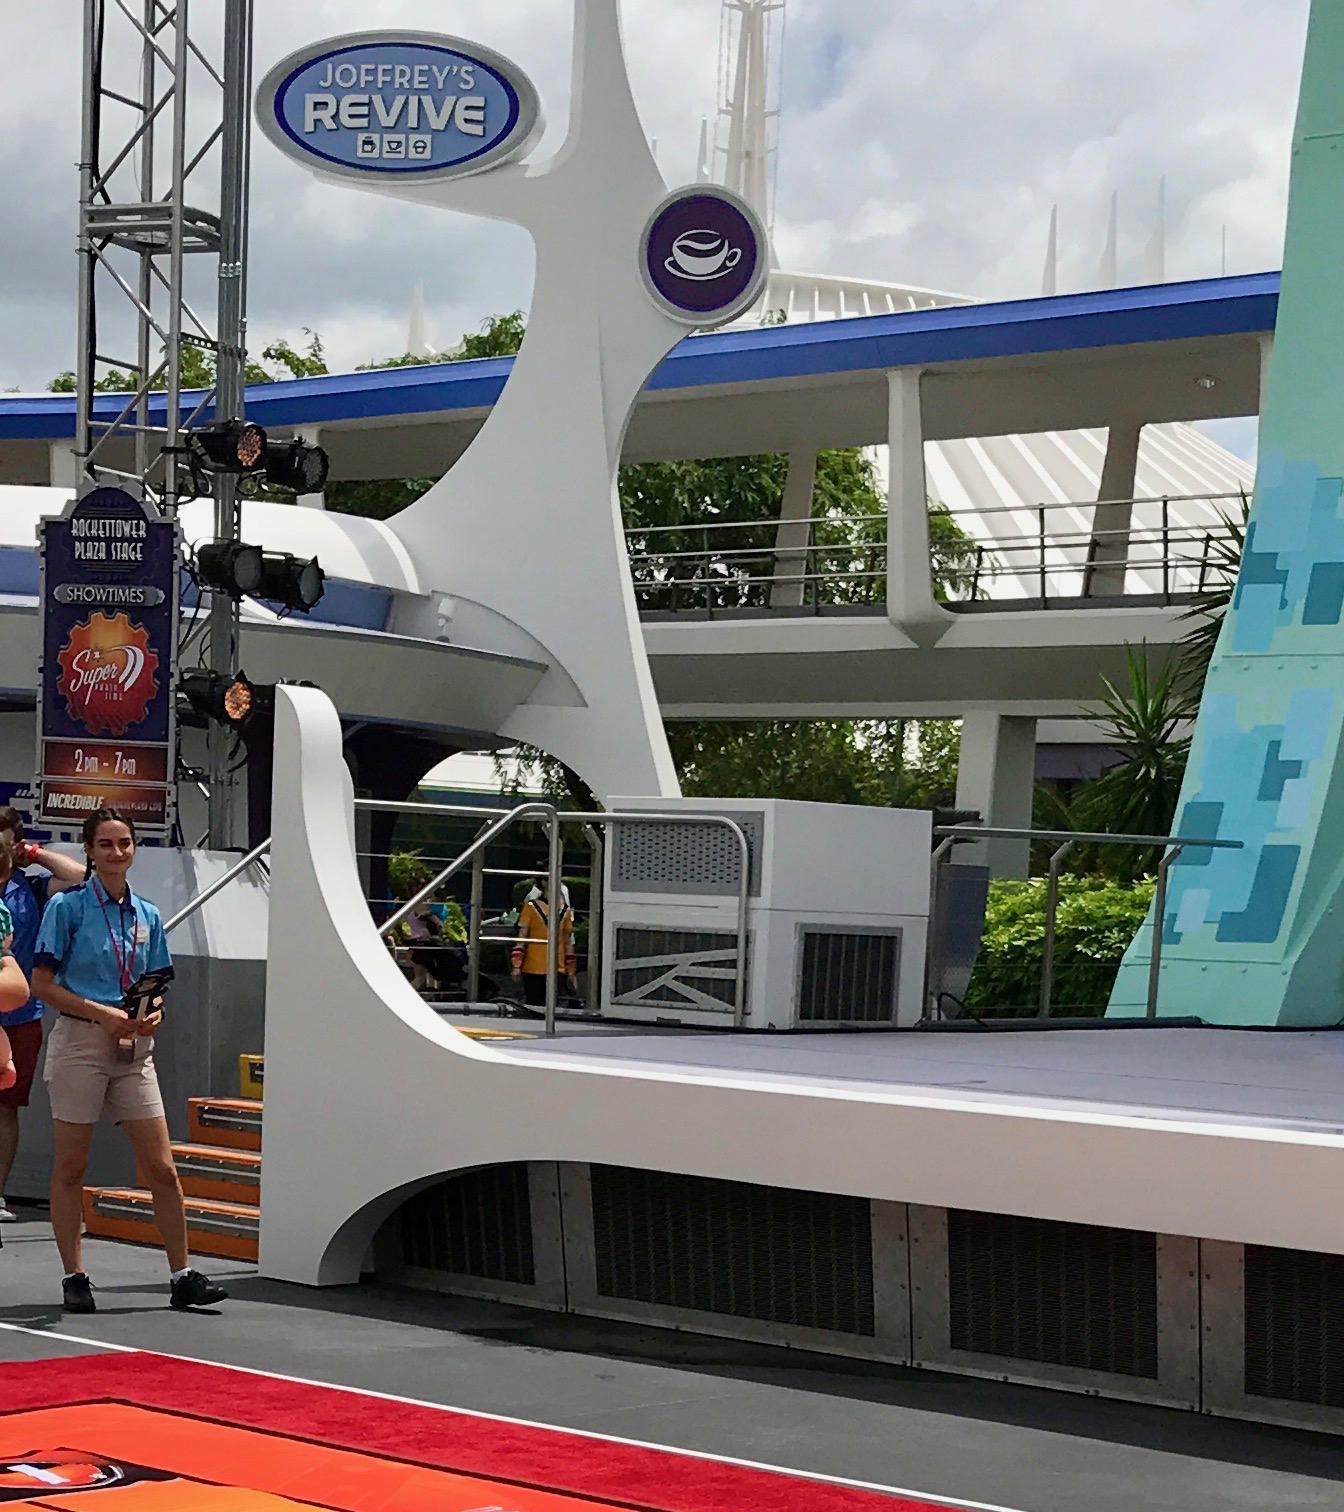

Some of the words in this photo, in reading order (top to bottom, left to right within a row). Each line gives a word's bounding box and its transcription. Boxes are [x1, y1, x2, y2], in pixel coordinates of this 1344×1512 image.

[318, 63, 476, 90] JOFFREY'S
[304, 93, 486, 137] REVIVE
[71, 519, 147, 538] ROCKETTOWER
[74, 542, 106, 560] PLAZA
[111, 542, 144, 561] STAGE
[67, 587, 144, 603] SHOWTIMES
[70, 648, 119, 706] Super
[46, 793, 104, 811] INCREDIBLE
